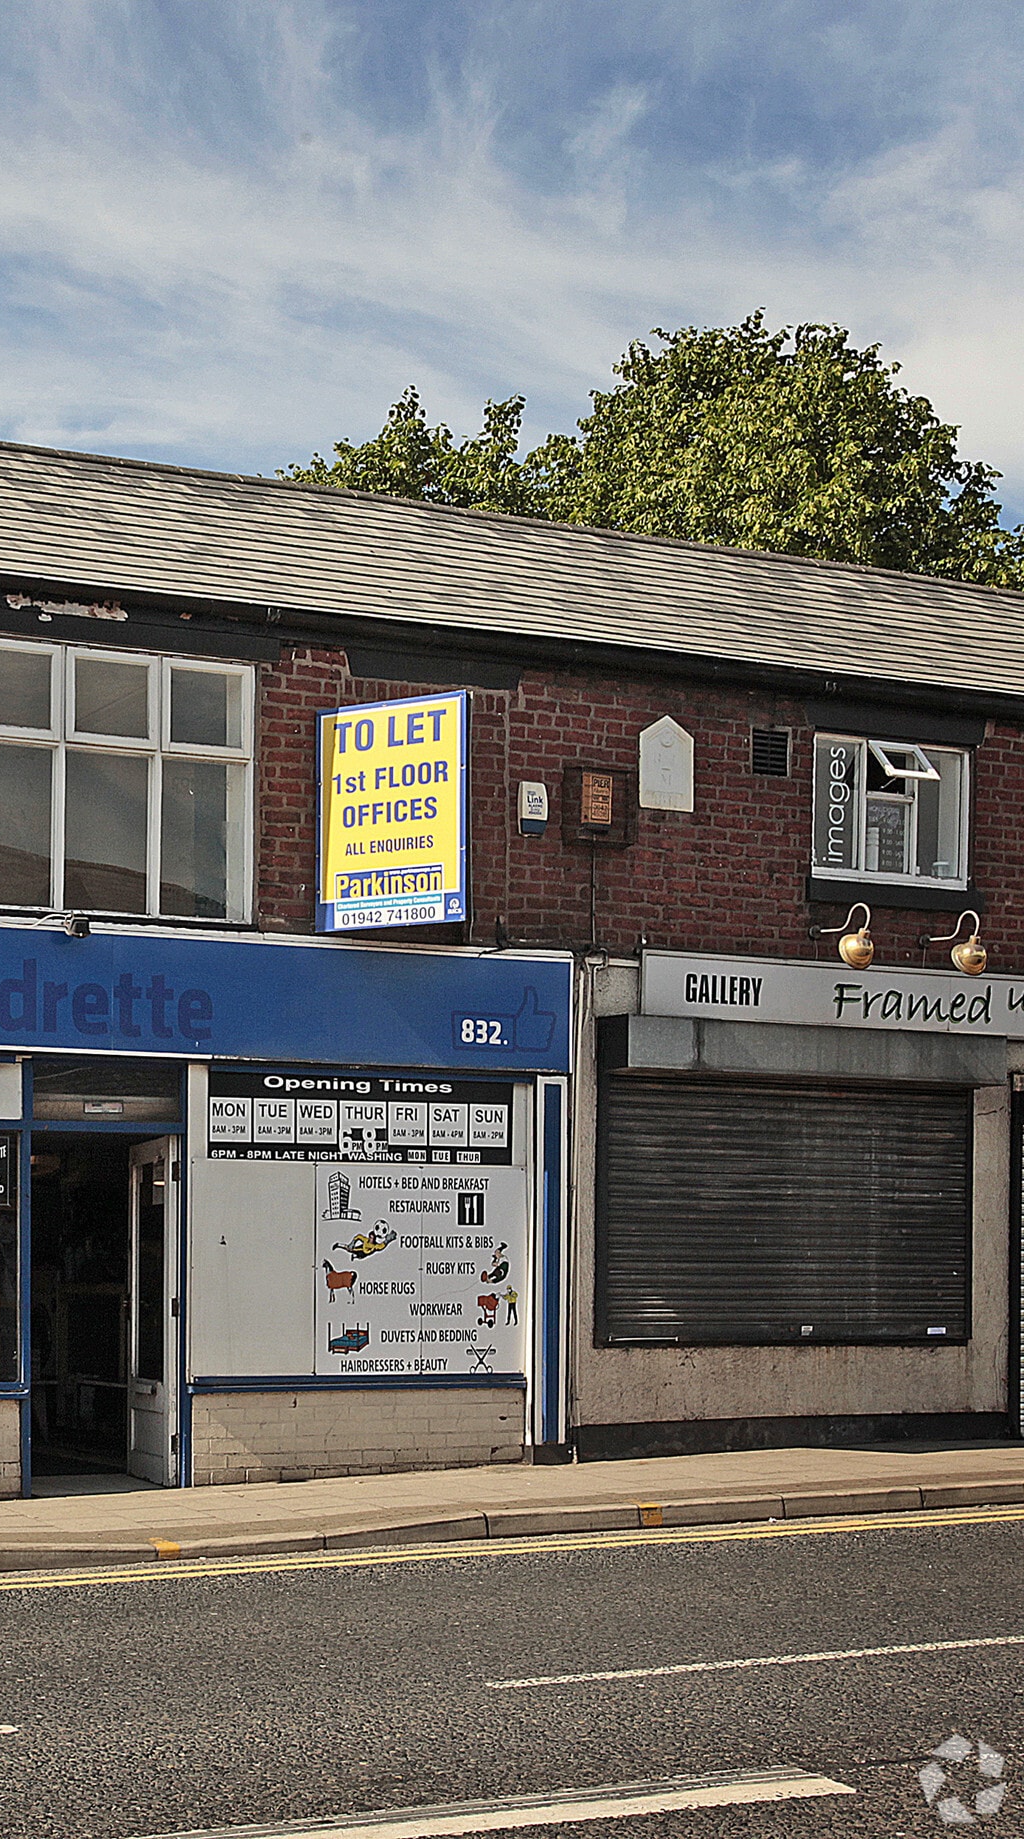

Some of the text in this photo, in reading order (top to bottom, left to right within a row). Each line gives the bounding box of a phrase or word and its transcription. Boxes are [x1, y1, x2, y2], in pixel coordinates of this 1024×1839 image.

[334, 709, 447, 754] TO LET
[332, 760, 448, 794] 1st FLOOR
[823, 746, 850, 863] images
[343, 796, 437, 828] OFFICES
[345, 835, 434, 856] ALL ENQUIRIES
[336, 871, 442, 899] Parkinson
[342, 906, 436, 925] 01942 741800
[685, 973, 763, 1006] GALLERY
[833, 982, 993, 1024] Framed
[264, 1076, 453, 1094] Opening Times
[212, 1103, 246, 1117] MON
[259, 1104, 288, 1118] TUE
[300, 1105, 333, 1119] WED
[345, 1106, 384, 1120] THUR
[396, 1107, 418, 1121] FRI
[433, 1108, 460, 1122] SAT
[475, 1109, 503, 1123] SUN
[211, 1150, 236, 1159] 6PM
[247, 1150, 272, 1159] 8PM
[275, 1151, 306, 1160] LATE
[308, 1151, 342, 1160] NIGHT
[348, 1152, 402, 1161] WASHING
[408, 1152, 425, 1160] MON
[434, 1152, 449, 1161] TUE
[458, 1152, 480, 1161] THUR
[359, 1176, 392, 1189] HOTELS
[401, 1177, 419, 1190] BED
[421, 1177, 440, 1190] AND
[442, 1177, 489, 1191] BREAKFAST
[389, 1200, 450, 1213] RESTAURANTS
[400, 1236, 494, 1249] FOOTBALL KITS & BIBS
[426, 1262, 476, 1275] RUGBY KITS
[359, 1282, 416, 1295] HORSE RUGS
[409, 1303, 463, 1316] WORKWEAR
[380, 1329, 477, 1343] DUVETS AND BEDDING
[341, 1359, 405, 1373] HAIRDRESSERS
[413, 1358, 448, 1371] BEAUTY
